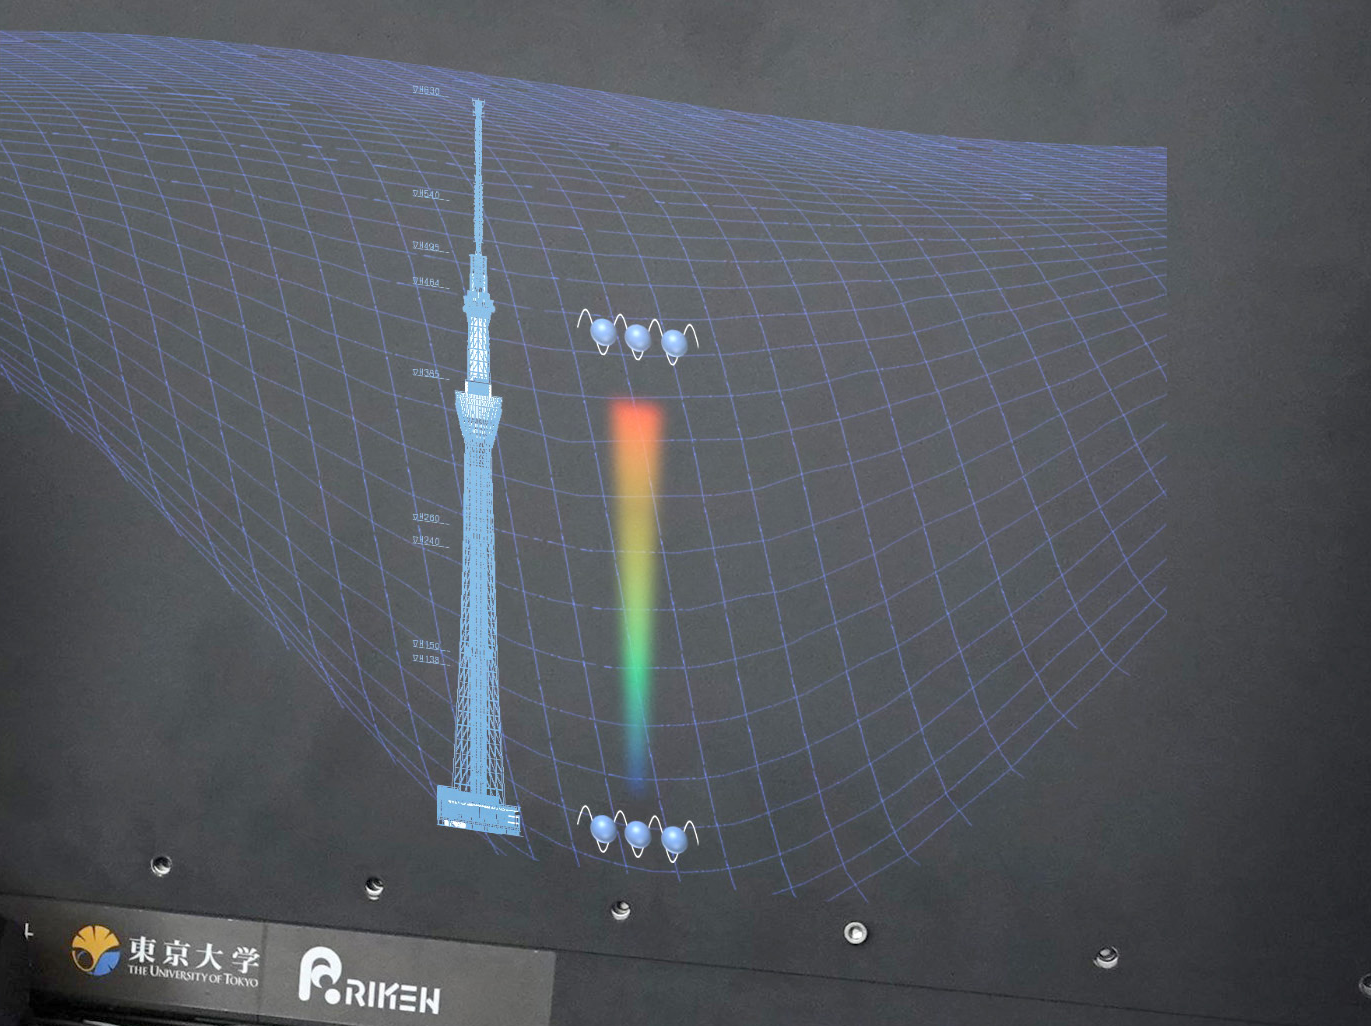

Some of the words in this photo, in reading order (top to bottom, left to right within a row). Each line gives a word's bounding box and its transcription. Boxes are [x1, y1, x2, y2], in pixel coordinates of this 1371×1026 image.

[128, 935, 260, 974] 東京大学
[128, 965, 148, 976] THE
[149, 965, 208, 982] UNIVERSITY
[209, 974, 223, 984] OF
[223, 972, 259, 988] TOKYO
[345, 978, 441, 1015] RIKEN
